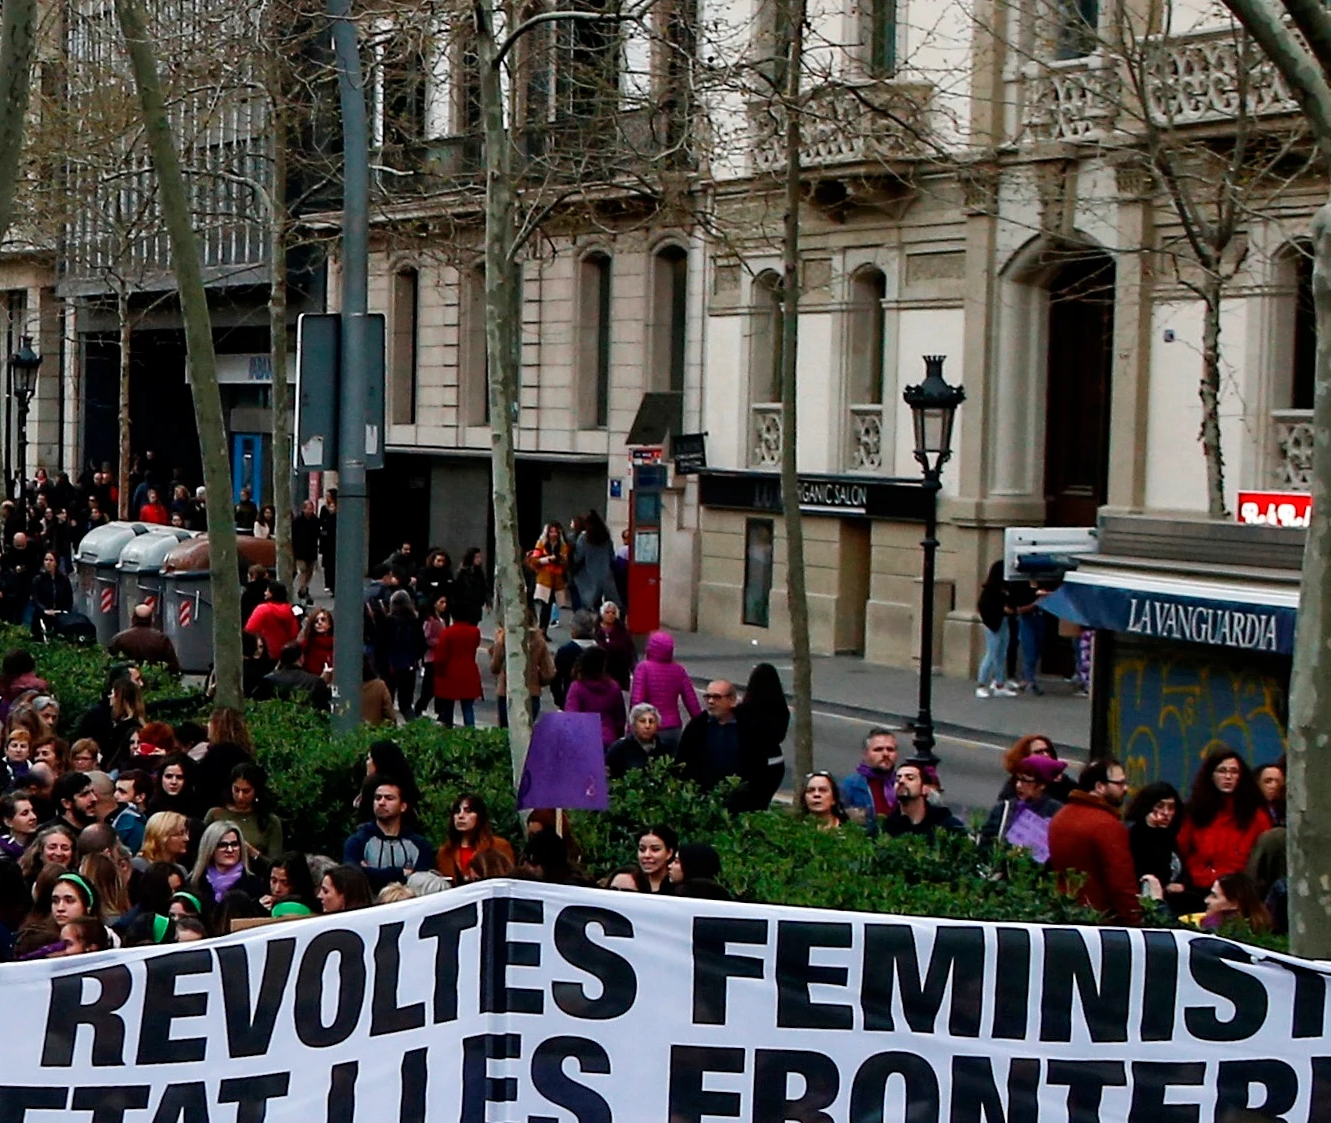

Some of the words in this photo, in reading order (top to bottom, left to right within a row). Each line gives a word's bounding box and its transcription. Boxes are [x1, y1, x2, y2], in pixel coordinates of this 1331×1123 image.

[1127, 599, 1152, 634] LA
[1153, 602, 1277, 651] VANGUARDIA
[40, 898, 636, 1067] REVOLTES
